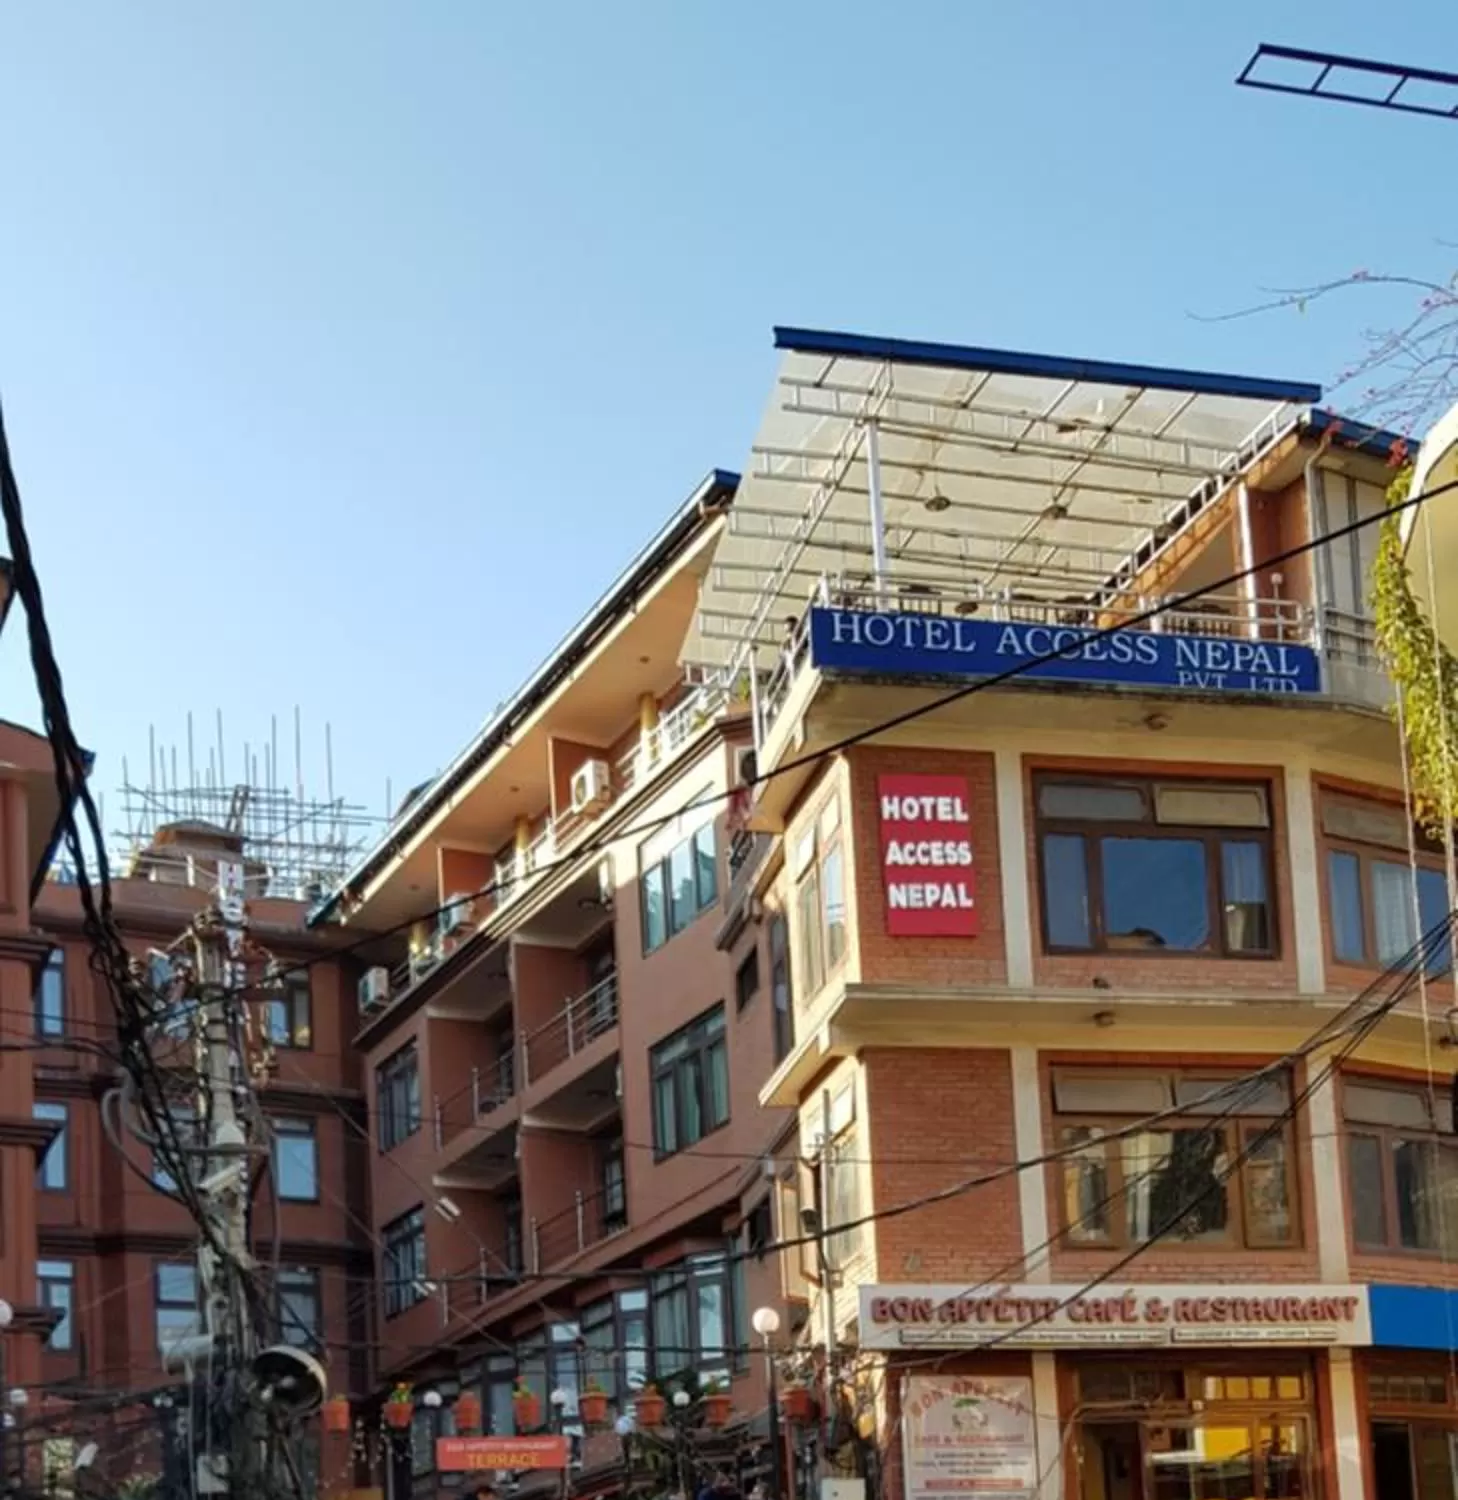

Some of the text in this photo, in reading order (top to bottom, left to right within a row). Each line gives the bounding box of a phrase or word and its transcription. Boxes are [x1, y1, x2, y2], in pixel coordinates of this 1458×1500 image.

[832, 612, 1299, 675] HOTEL ACCESS NEPAL
[881, 795, 969, 821] HOTEL
[885, 840, 973, 866] ACCESS
[888, 883, 974, 908] NEPAL
[871, 1297, 932, 1323] BON
[1144, 1297, 1169, 1323] &
[1173, 1296, 1359, 1322] RESTAURANT
[467, 1452, 541, 1468] TERRACE
